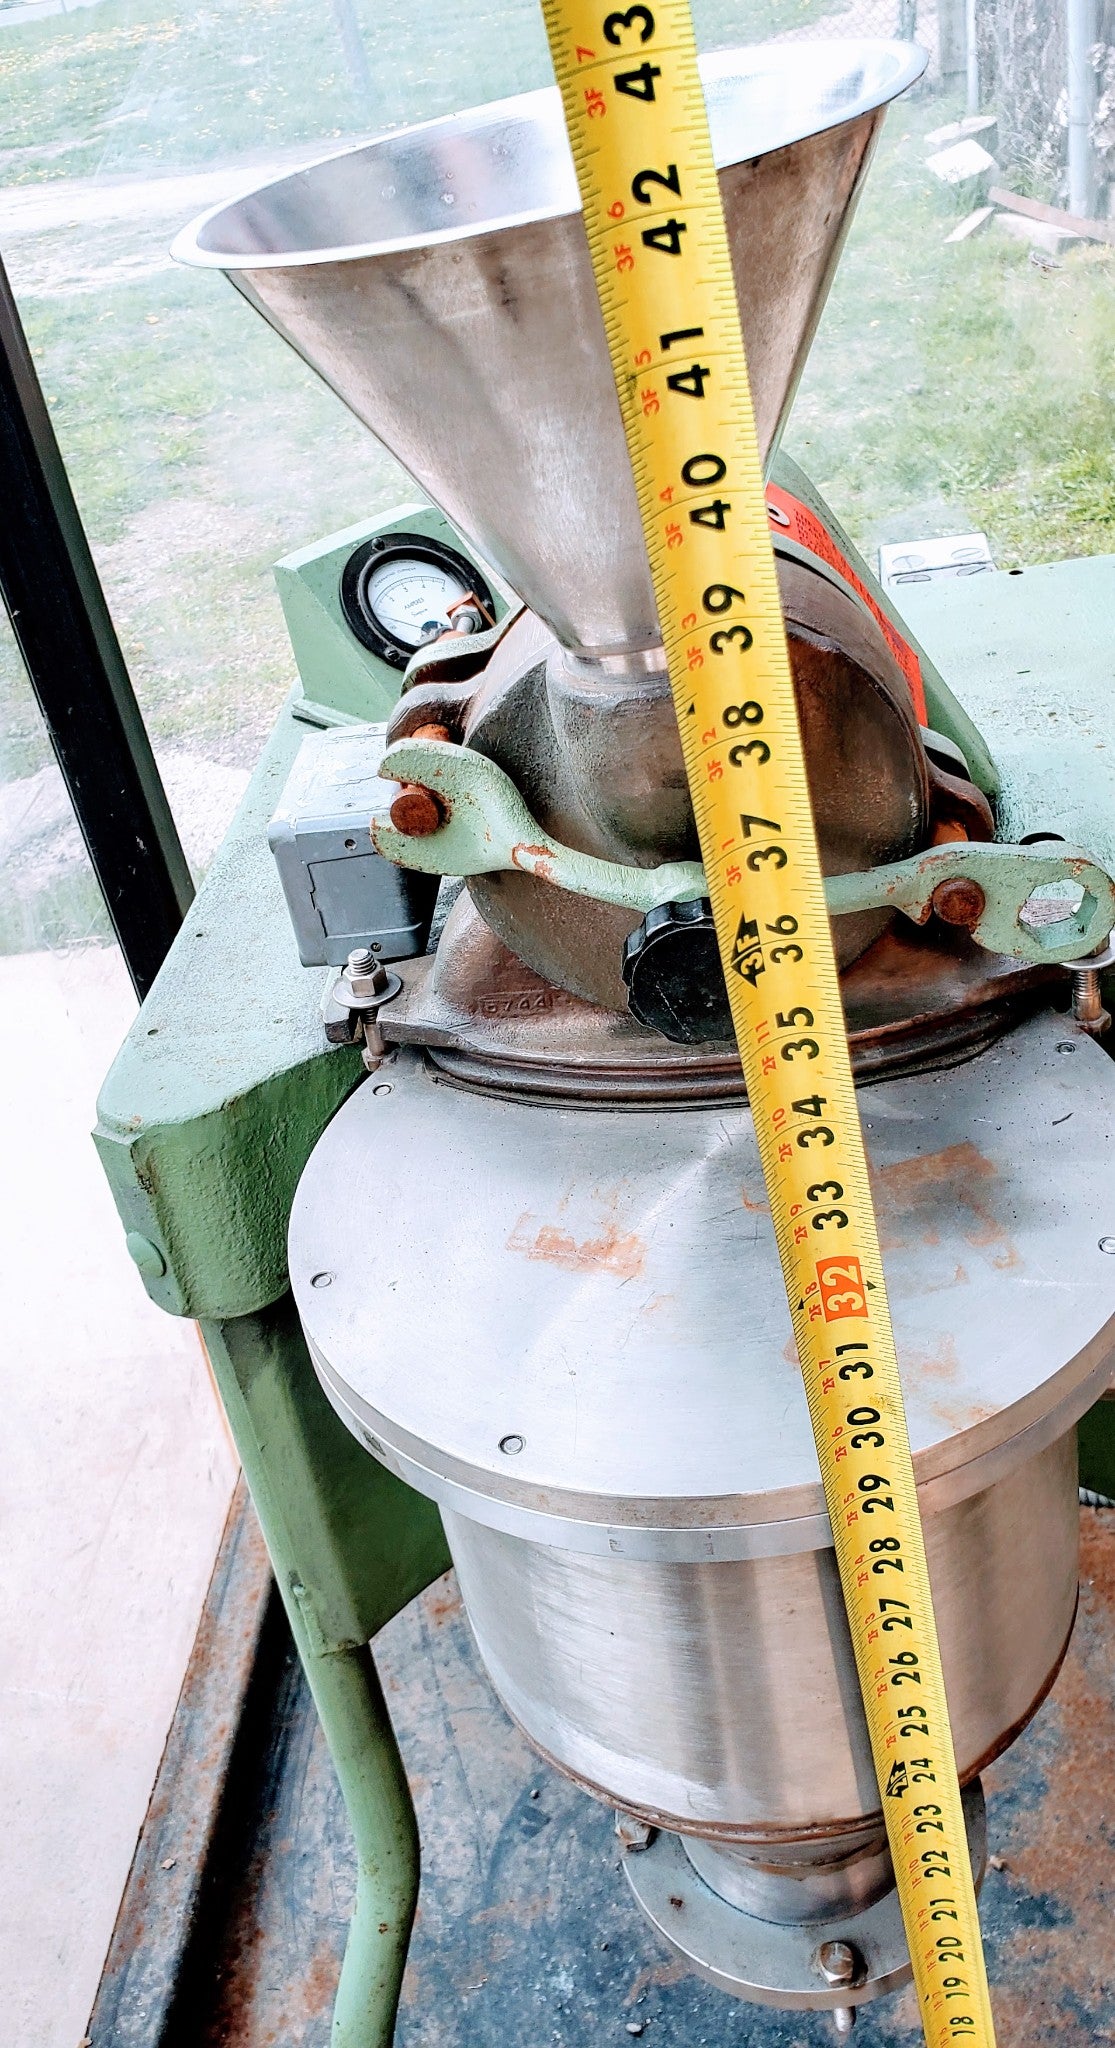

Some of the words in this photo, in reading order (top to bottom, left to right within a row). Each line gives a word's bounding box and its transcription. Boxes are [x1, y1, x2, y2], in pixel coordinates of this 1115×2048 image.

[576, 46, 596, 62] 7
[603, 5, 660, 101] 43
[585, 89, 607, 118] 3F
[608, 200, 625, 220] 6
[632, 165, 686, 254] 42
[614, 244, 635, 272] 3F
[635, 348, 652, 366] 5
[660, 328, 710, 397] 41
[641, 388, 660, 416] 3F
[658, 486, 674, 503] 4
[682, 454, 730, 529] 40
[665, 522, 684, 548] 3F
[681, 612, 697, 628] 3
[703, 585, 753, 652] 39
[687, 647, 704, 671] 3F
[701, 728, 716, 744] 2
[724, 701, 770, 766] 38
[707, 760, 724, 781] 3F
[721, 838, 734, 850] 1
[741, 815, 787, 870] 37
[726, 866, 742, 886] 3F
[765, 915, 803, 963] 36
[736, 934, 763, 975] 3F
[754, 1021, 769, 1041] 11
[777, 1007, 819, 1060] 35
[761, 1057, 776, 1076] 2F
[772, 1108, 785, 1130] 10
[793, 1095, 834, 1147] 34
[778, 1143, 792, 1162] 2F
[790, 1204, 801, 1216] 9
[807, 1181, 848, 1230] 33
[794, 1226, 808, 1245] 2F
[804, 1281, 817, 1294] 8
[821, 1264, 864, 1313] 32
[808, 1304, 822, 1322] 2F
[819, 1360, 830, 1369] 7
[836, 1344, 873, 1380] 31
[822, 1378, 835, 1394] 2F
[832, 1426, 843, 1438] 6
[847, 1407, 884, 1448] 30
[835, 1447, 847, 1461] 2F
[845, 1493, 854, 1503] 5
[858, 1475, 894, 1513] 29
[847, 1512, 858, 1525] 2F
[855, 1554, 865, 1565] 4
[869, 1538, 903, 1573] 28
[858, 1573, 868, 1587] 2F
[865, 1612, 876, 1623] 3
[879, 1599, 912, 1631] 27
[868, 1630, 878, 1643] 2F
[876, 1667, 885, 1678] 2
[889, 1652, 920, 1685] 26
[877, 1684, 887, 1696] 2F
[884, 1720, 893, 1730] 1
[898, 1706, 928, 1736] 25
[886, 1735, 897, 1748] 2F
[911, 1759, 935, 1782] 24
[914, 1805, 943, 1832] 23
[921, 1851, 950, 1877] 22
[930, 1899, 957, 1920] 21
[936, 1937, 963, 1961] 20
[943, 1977, 970, 1999] 19
[950, 2016, 975, 2037] 18
